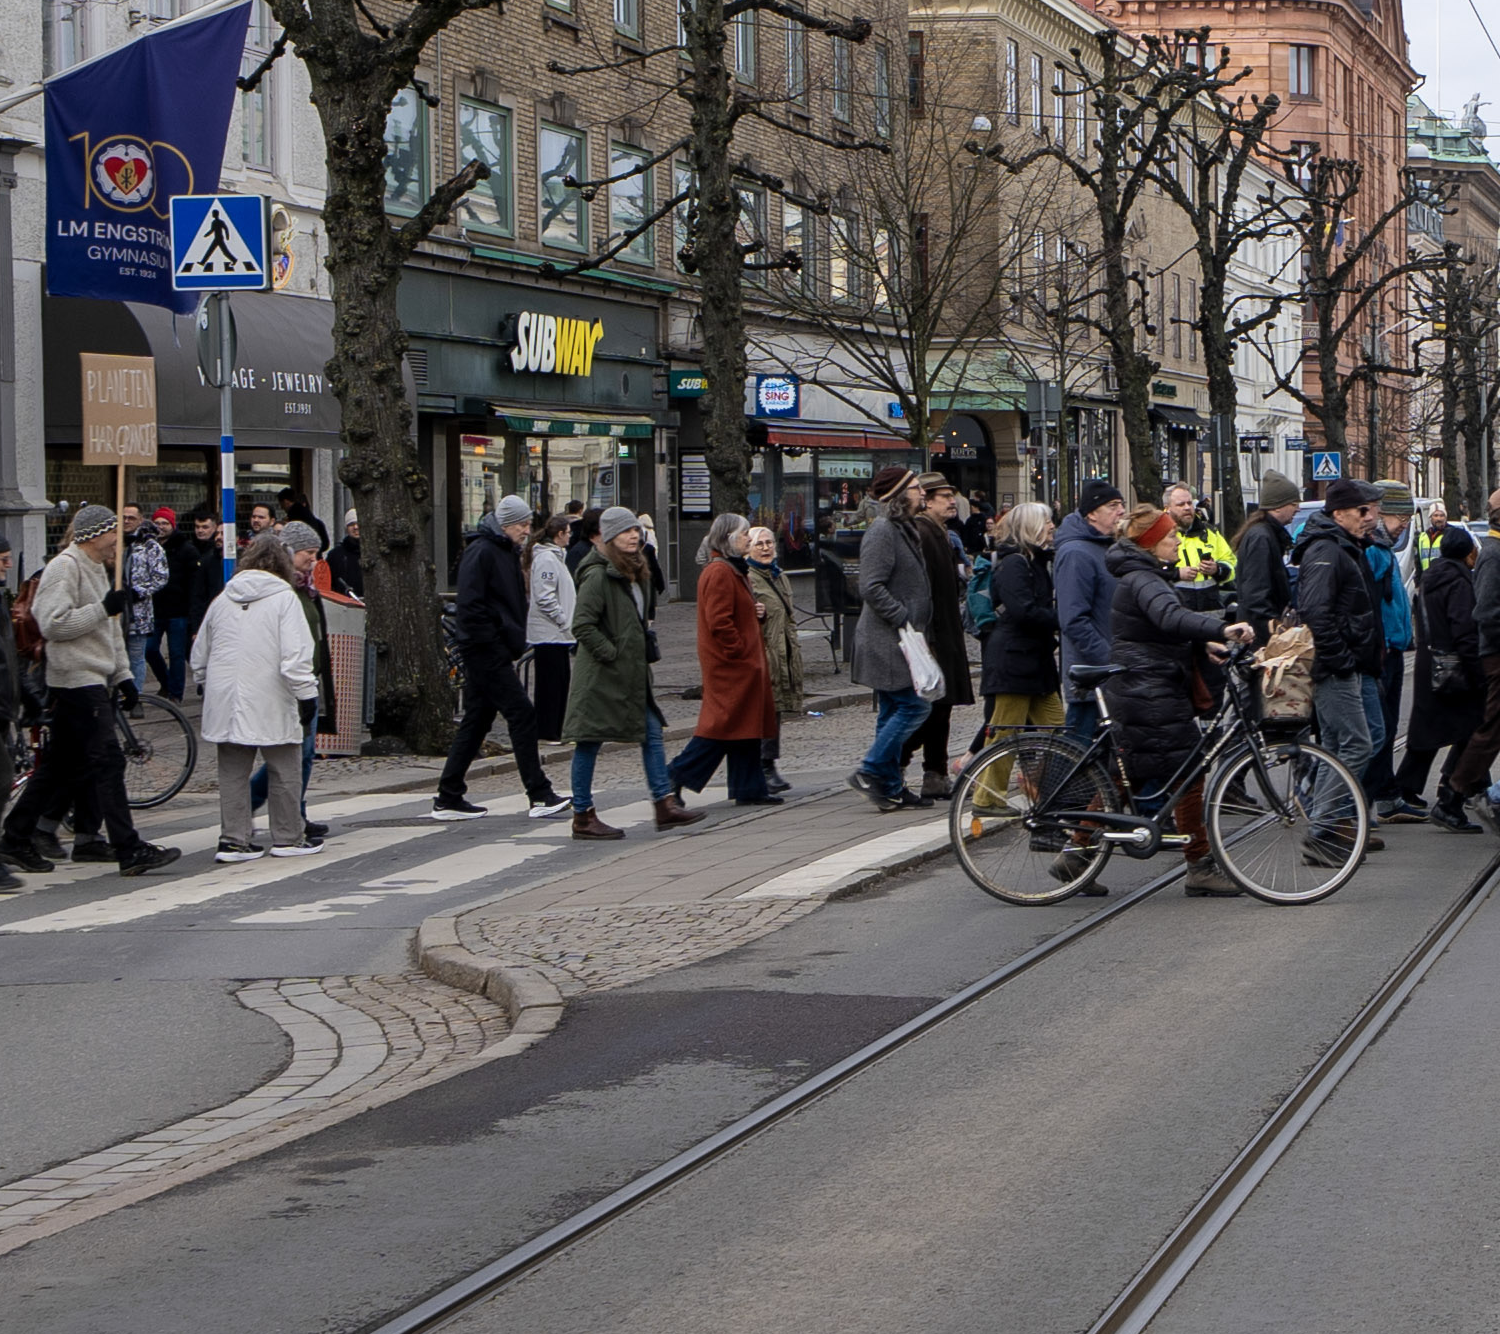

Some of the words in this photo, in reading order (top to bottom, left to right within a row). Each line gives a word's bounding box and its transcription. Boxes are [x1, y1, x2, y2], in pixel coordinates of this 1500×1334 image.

[57, 220, 88, 237] LM
[119, 267, 137, 276] EST.
[511, 311, 604, 377] SUBWAY
[87, 369, 154, 409] PLANETEN
[272, 371, 323, 394] JEWELRY
[765, 391, 789, 401] SING
[89, 425, 114, 453] HAR
[541, 571, 554, 580] 83
